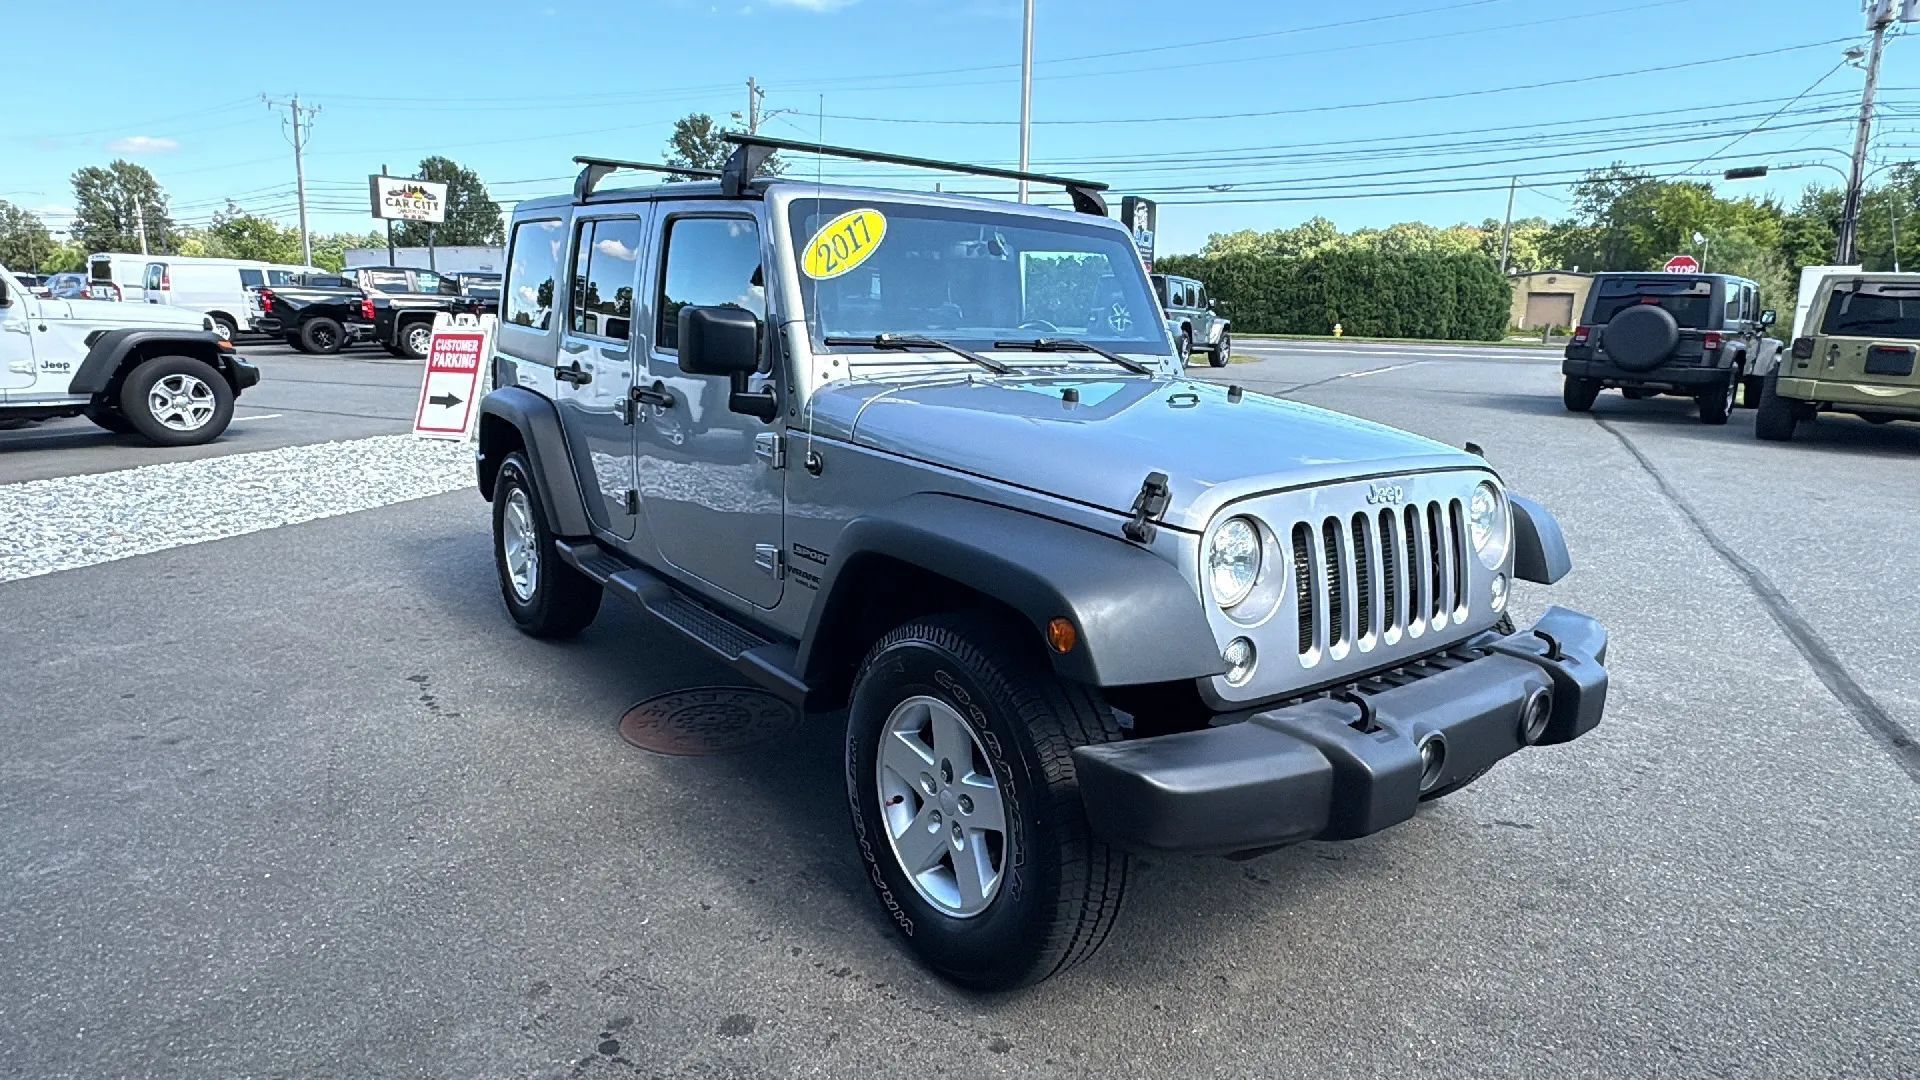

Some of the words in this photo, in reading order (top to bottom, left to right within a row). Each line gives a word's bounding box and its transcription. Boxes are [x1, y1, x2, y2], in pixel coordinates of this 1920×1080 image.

[386, 197, 410, 208] CAR
[414, 201, 439, 210] CITY
[817, 214, 871, 273] 2017
[1667, 265, 1695, 274] STOP
[435, 339, 478, 352] CUSTOMER
[40, 360, 70, 370] Jeep
[432, 352, 476, 368] PARKING
[1366, 482, 1403, 505] Jeep
[934, 669, 1025, 901] GOODYEAR
